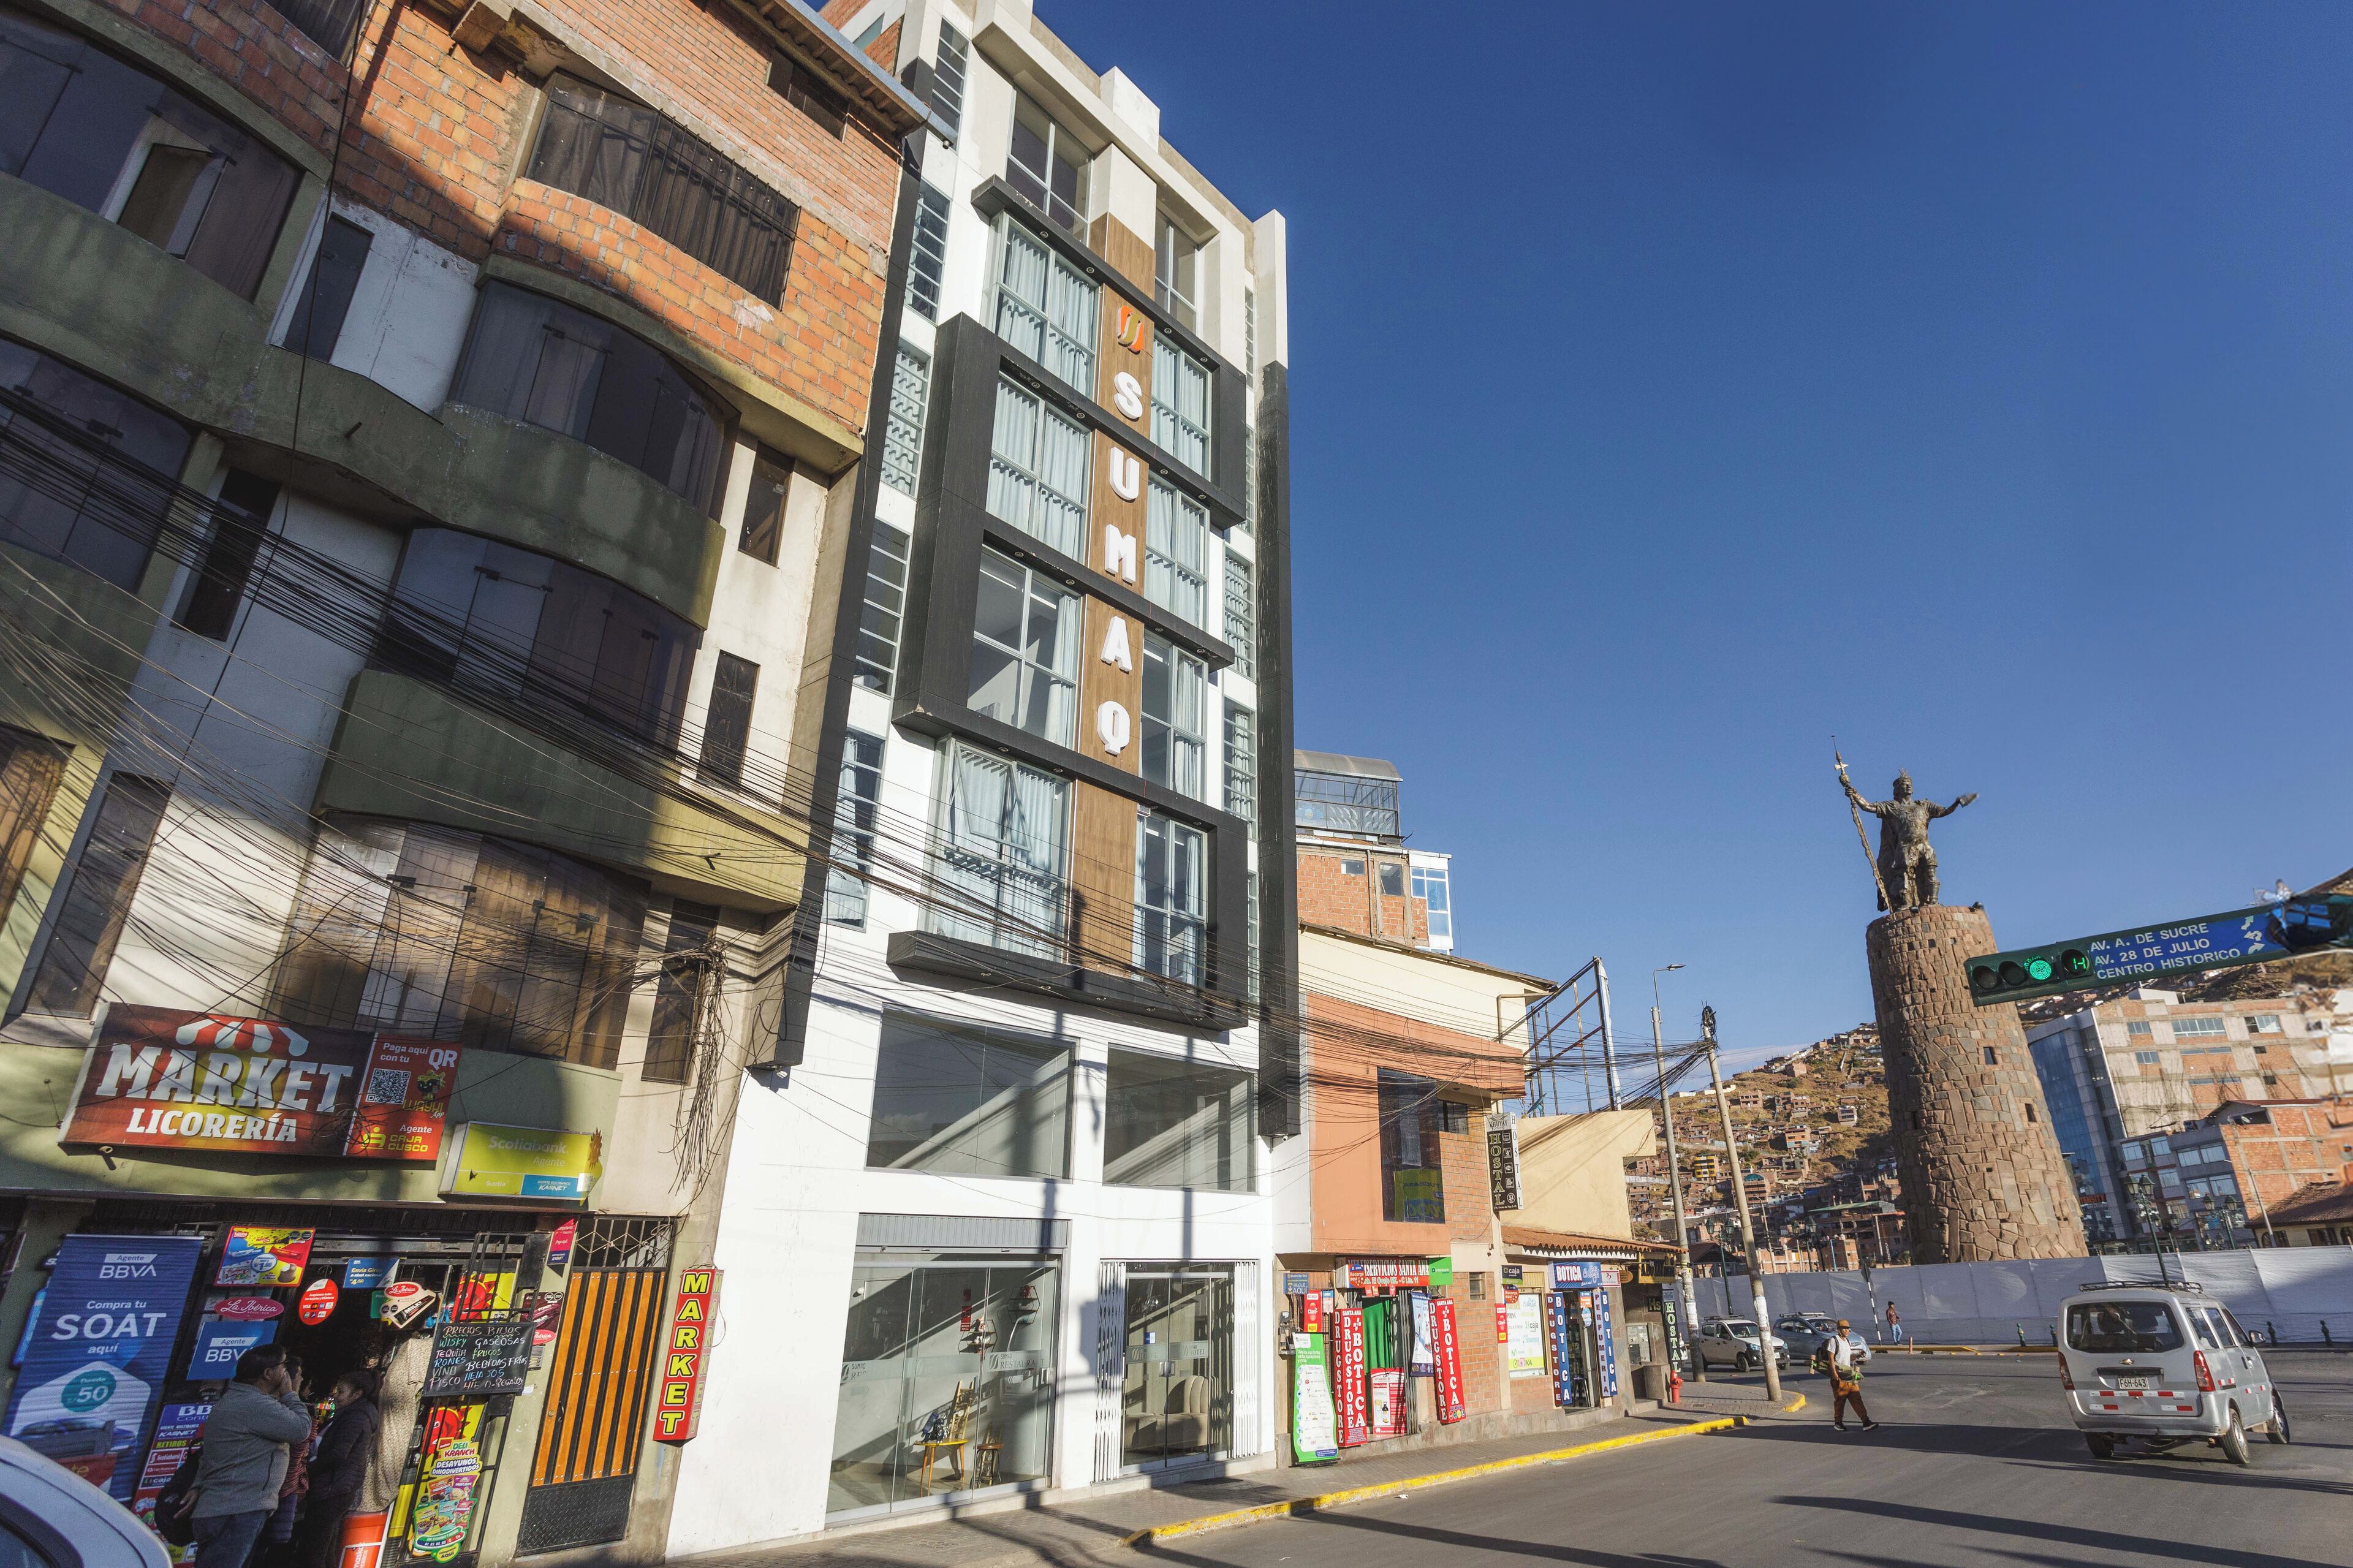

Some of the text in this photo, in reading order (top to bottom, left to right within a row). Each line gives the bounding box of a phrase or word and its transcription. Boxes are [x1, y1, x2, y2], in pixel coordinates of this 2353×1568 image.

[1097, 371, 1143, 755] SUMAQ
[2091, 923, 2209, 952] AV. A. DE SUCRE
[2094, 938, 2210, 966] AV. 28 DE JULIO
[2097, 949, 2240, 979] CENTRO HISTORICO
[383, 1042, 406, 1053] Paga
[429, 1048, 458, 1070] QR
[95, 1043, 354, 1113] MARKET
[126, 1108, 297, 1142] LICORERÍA
[400, 1124, 432, 1134] Agente
[388, 1143, 428, 1152] CUSCO
[488, 1135, 568, 1154] Scotiabank
[533, 1157, 564, 1167] Agente
[1489, 1133, 1505, 1205] HOSTAL
[1511, 1115, 1522, 1208] HOSTAL
[99, 1264, 157, 1279] BBVA
[1398, 1259, 1429, 1276] SANTA ANA
[1556, 1265, 1582, 1281] BOTICA
[86, 1300, 131, 1310] Compra
[221, 1300, 277, 1313] La Ibérica
[404, 1301, 423, 1314] MILKY
[51, 1312, 167, 1340] SOAT
[443, 1326, 521, 1336] PRECIOS BAJOS
[1665, 1302, 1681, 1373] HOSTAL
[88, 1343, 119, 1355] aquí
[439, 1338, 467, 1347] WISKY
[475, 1337, 525, 1349] GASEOSAS
[660, 1272, 710, 1435] MARKET
[690, 1273, 723, 1434] MARKET
[1547, 1297, 1561, 1401] DRUGSTORE
[1556, 1296, 1570, 1401] BOTICA
[1595, 1294, 1608, 1393] PERFUMERIA
[1602, 1295, 1617, 1392] BOTICA
[205, 1347, 253, 1362] BBV
[434, 1357, 466, 1367] RONES
[1430, 1302, 1447, 1420] DRUGSTORE
[1443, 1319, 1459, 1405] BOTICA
[430, 1377, 461, 1389] PISCO
[1335, 1311, 1344, 1443] DRUGSTORE
[1344, 1317, 1354, 1428] DRUGSTORE
[1352, 1333, 1366, 1427] BOTICA
[2120, 1379, 2146, 1387] F6H-643
[77, 1385, 108, 1403] 50
[436, 1457, 477, 1468] DESAYUNOS
[444, 1448, 475, 1457] KRANCH
[432, 1464, 480, 1474] DINODIVERTIDOS
